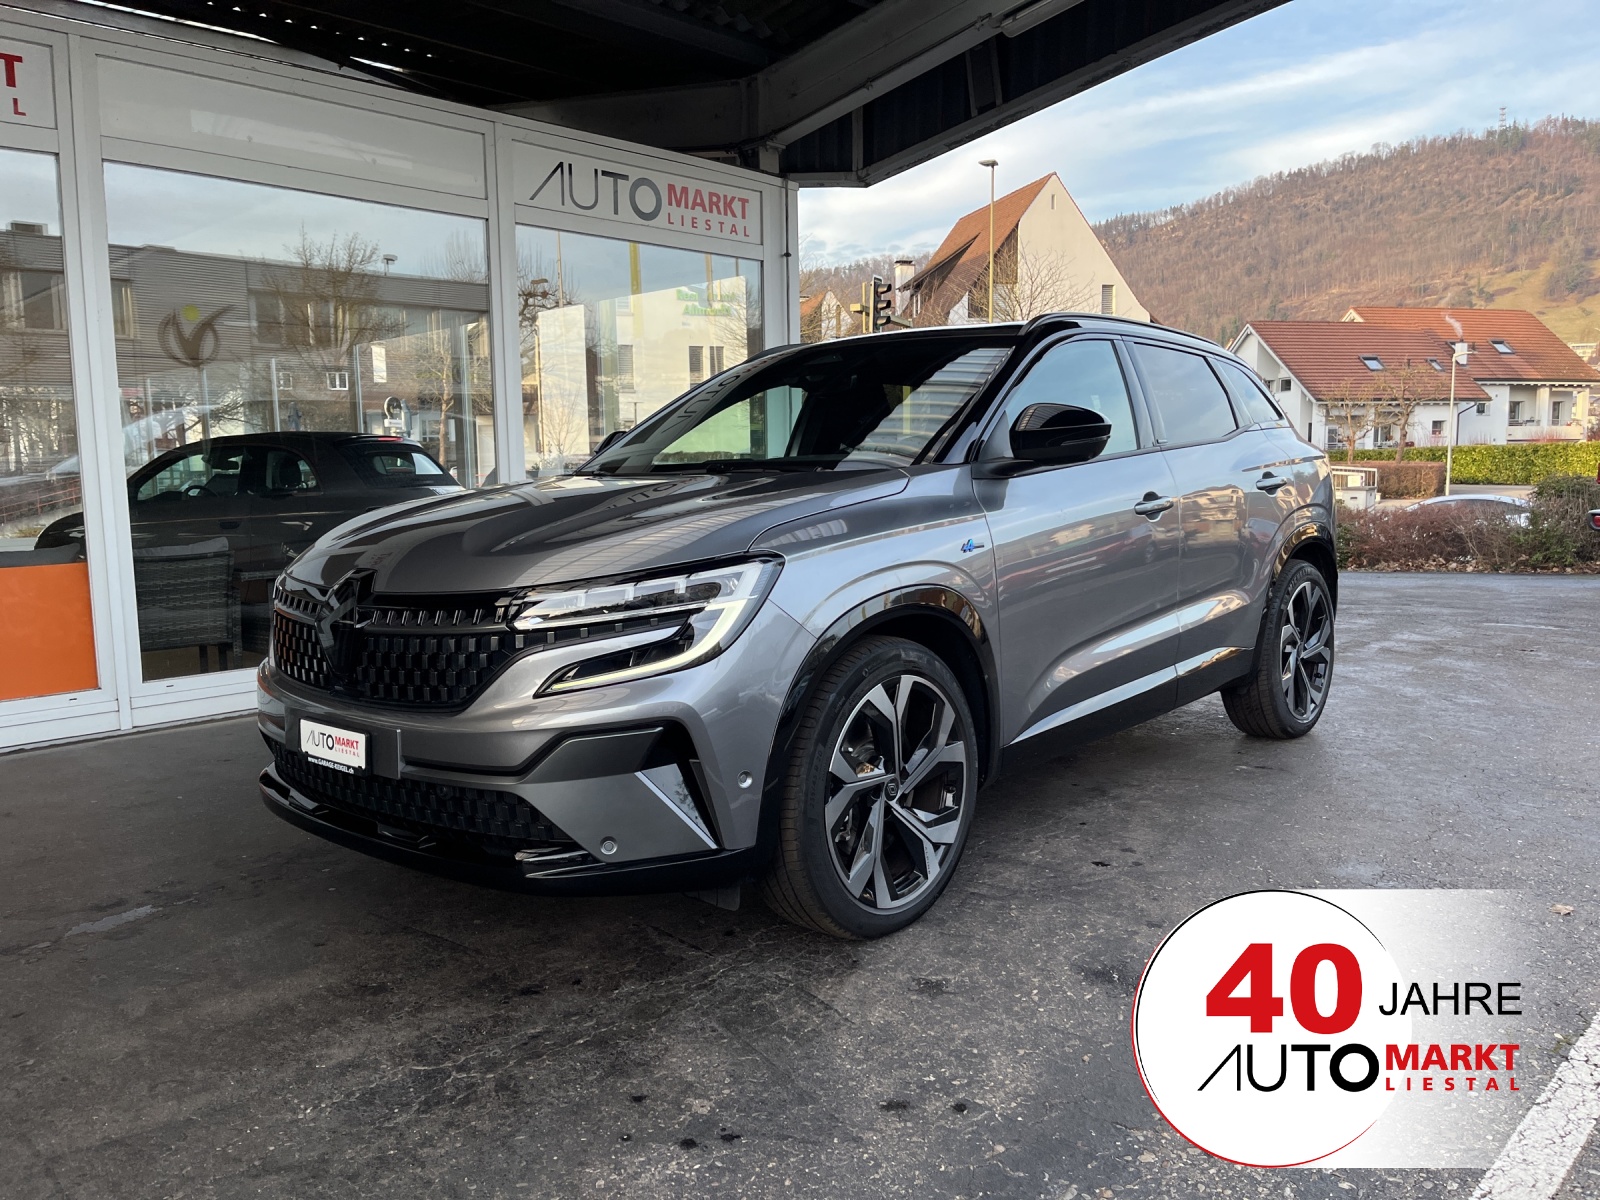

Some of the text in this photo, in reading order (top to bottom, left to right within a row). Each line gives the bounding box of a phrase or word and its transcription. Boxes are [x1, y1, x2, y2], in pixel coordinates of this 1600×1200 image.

[529, 161, 750, 222] AUTO MARKT
[667, 212, 750, 238] LIESTAL
[306, 730, 359, 751] AUTO MARKT
[334, 747, 360, 758] LIESTAL
